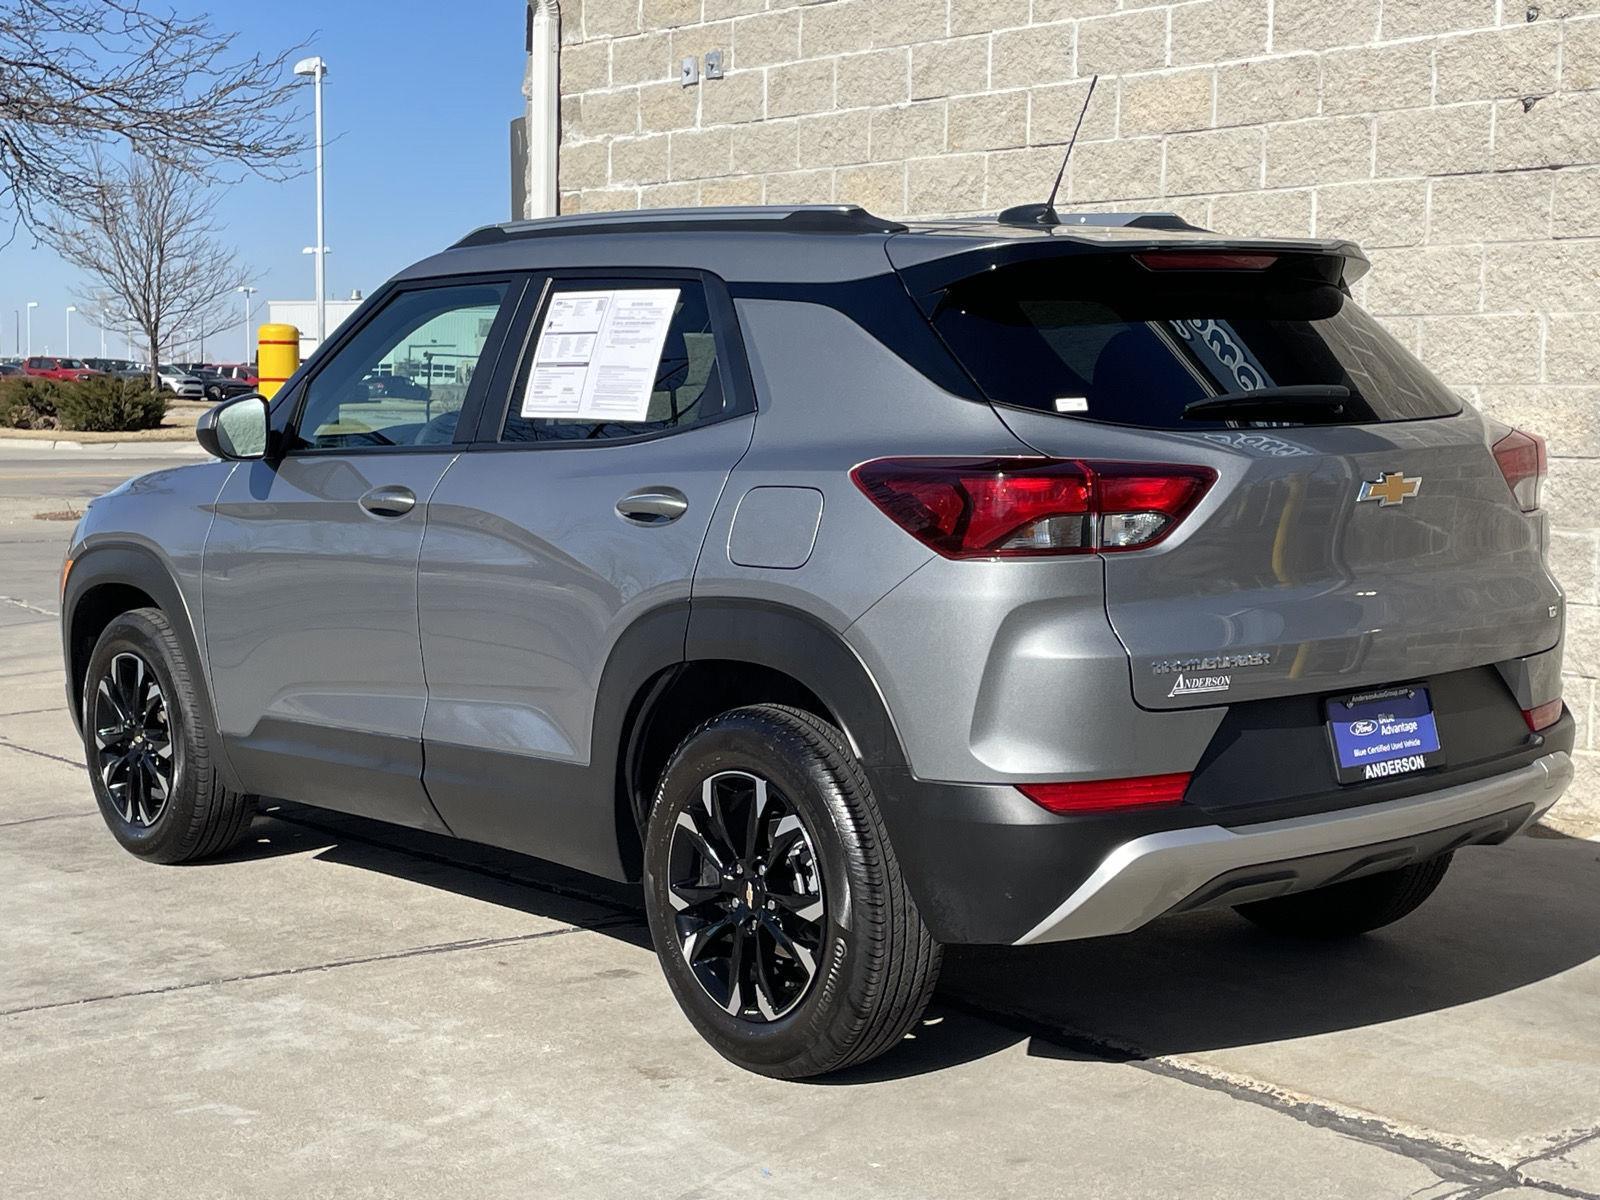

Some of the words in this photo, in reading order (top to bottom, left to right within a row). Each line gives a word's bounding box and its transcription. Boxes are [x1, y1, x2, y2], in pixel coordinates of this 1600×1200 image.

[1167, 673, 1232, 698] ANDERSON
[1381, 721, 1418, 736] Advantage
[1353, 748, 1367, 758] Blue
[1367, 744, 1391, 755] Certified
[1364, 754, 1426, 780] ANDERSON
